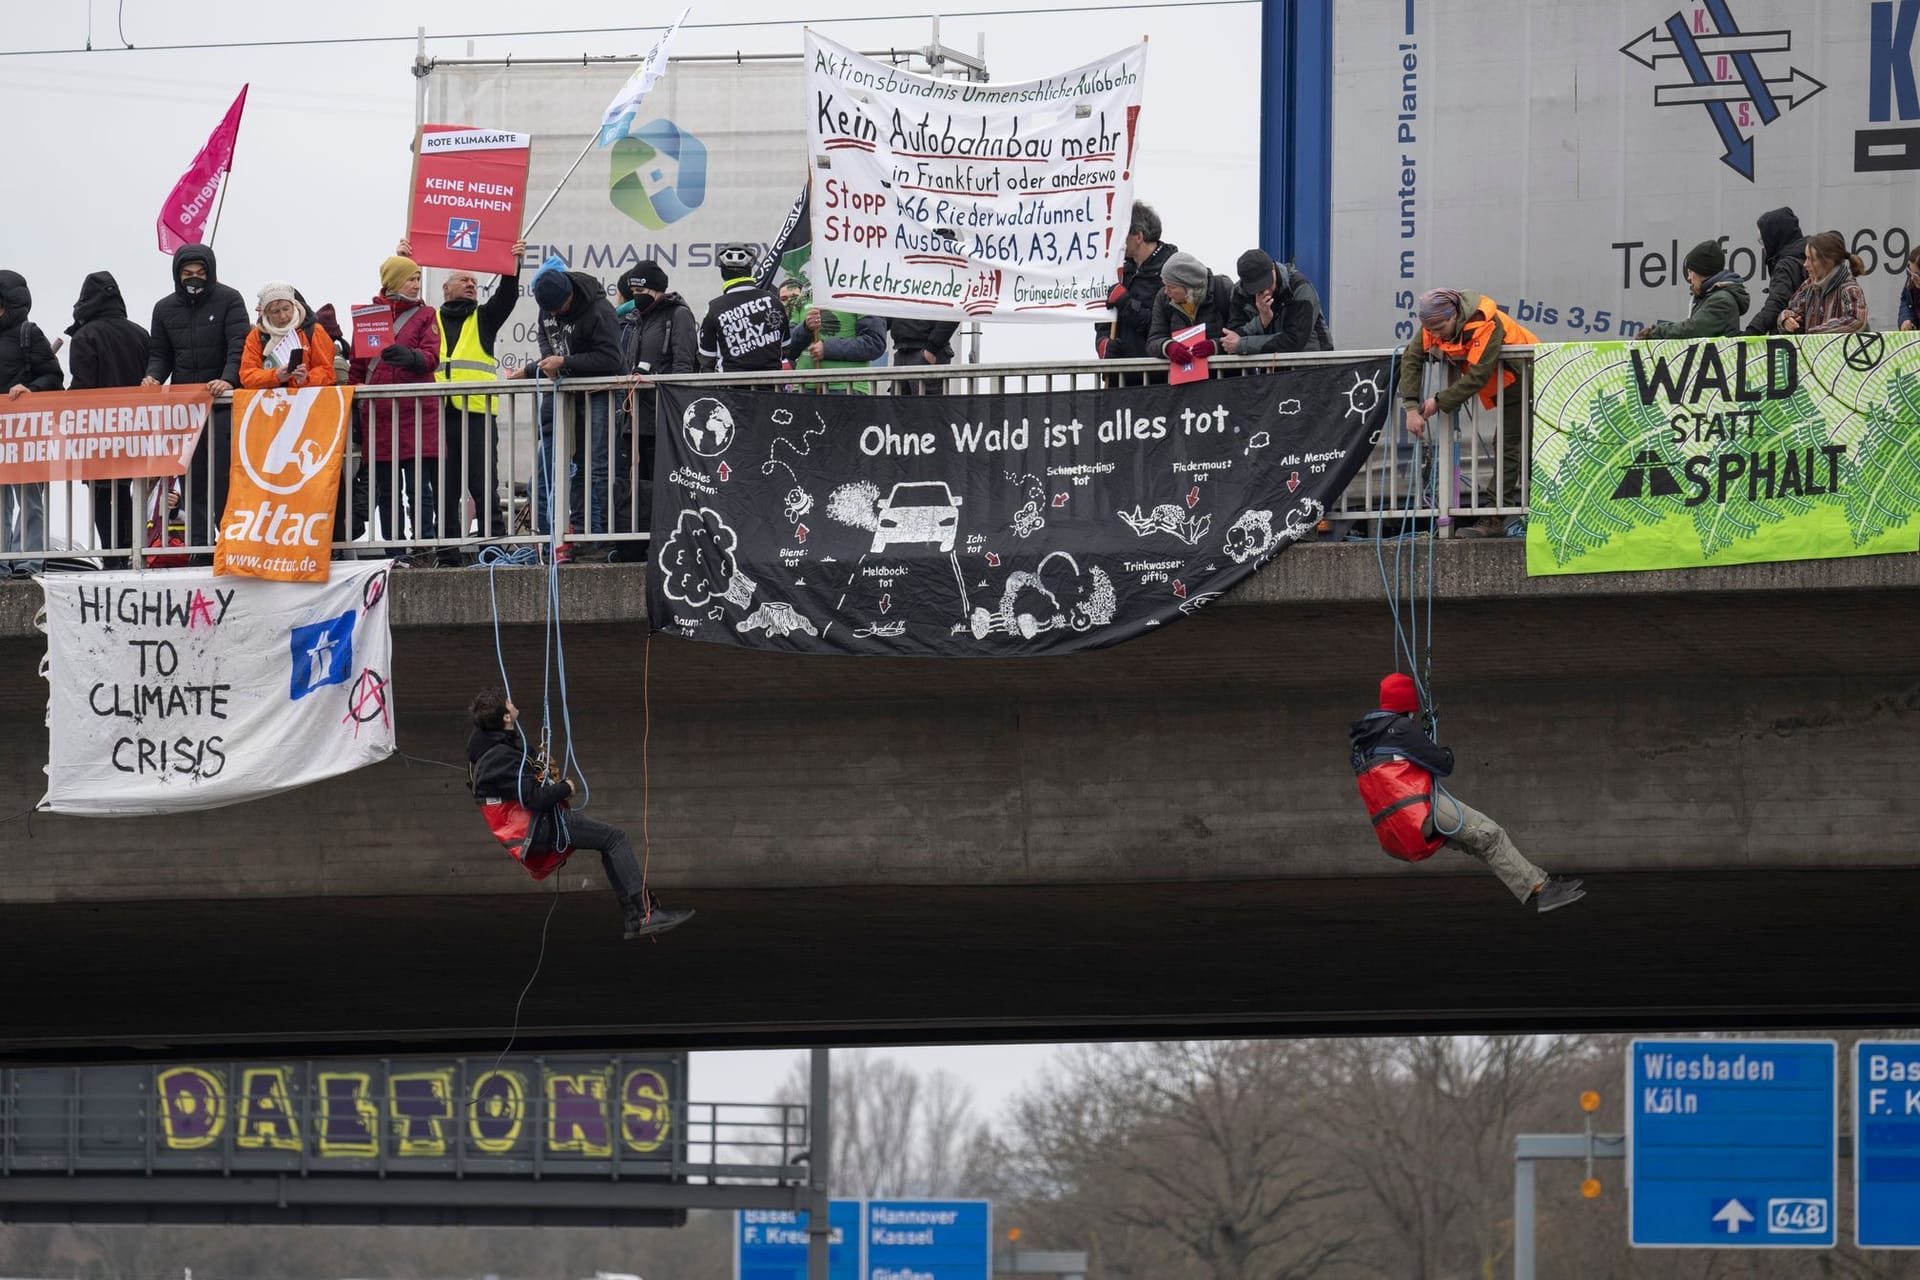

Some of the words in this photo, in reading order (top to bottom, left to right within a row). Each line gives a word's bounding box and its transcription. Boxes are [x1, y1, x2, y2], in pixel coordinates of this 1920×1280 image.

[815, 49, 958, 101] Aktionsbündnis
[962, 77, 1073, 103] Unmenschliche
[1072, 62, 1137, 97] Autobahn
[1398, 43, 1417, 143] Plane!
[817, 91, 877, 142] Kein
[889, 108, 1052, 158] Autobahnbau
[428, 138, 452, 148] ROTE
[454, 134, 517, 146] KLIMAKARTE
[425, 177, 464, 192] KEINE
[468, 182, 514, 197] NEUEN
[893, 166, 910, 183] in
[917, 162, 1001, 190] Frankfurt
[1007, 166, 1046, 189] oder
[1052, 164, 1116, 187] anderswo
[423, 194, 512, 213] AUTOBAHNEN
[825, 179, 886, 215] Stopp
[1399, 155, 1416, 238] unter
[824, 216, 888, 248] Stopp
[896, 224, 966, 256] Ausbau
[584, 243, 677, 269] MAIN
[1400, 251, 1415, 278] m
[825, 257, 963, 298] Verkehrswende
[1014, 275, 1078, 305] Grüngebiete
[718, 296, 772, 327] PROTECT
[1395, 290, 1417, 340] 3,5
[1516, 299, 1559, 325] bis
[1567, 306, 1612, 334] 3,5
[723, 317, 754, 337] OUR
[725, 322, 766, 349] PLAY
[730, 330, 781, 357] GROUND
[1629, 338, 1799, 406] WALD
[59, 403, 207, 436] GENERATION
[860, 424, 936, 456] Ohne
[950, 418, 1029, 453] Wald
[1044, 417, 1083, 449] ist
[1098, 409, 1167, 442] alles
[1671, 410, 1762, 443] STATT
[23, 439, 60, 463] DEN
[1280, 454, 1301, 466] Alle
[1072, 475, 1091, 486] tot
[1194, 473, 1208, 482] tot
[1311, 463, 1327, 474] tot
[225, 501, 329, 547] attac
[225, 551, 318, 573] www.attac.de
[967, 545, 982, 554] tot
[784, 559, 800, 568] tot
[862, 565, 909, 577] Heldbock:
[1124, 559, 1186, 571] Trinkwasser:
[1141, 571, 1169, 583] giftig
[878, 578, 893, 588] tot
[78, 586, 237, 630] HIGHWAY
[128, 639, 178, 678] TO
[89, 682, 232, 720] CLIMATE
[111, 735, 227, 779] CRISIS
[1644, 1054, 1775, 1081] Wiesbaden
[158, 1066, 670, 1156] DALTONS
[1644, 1087, 1698, 1114] Köln
[1869, 1088, 1893, 1114] F.
[872, 1207, 959, 1224] Hannover
[1775, 1204, 1821, 1228] 648
[872, 1227, 934, 1245] Kassel
